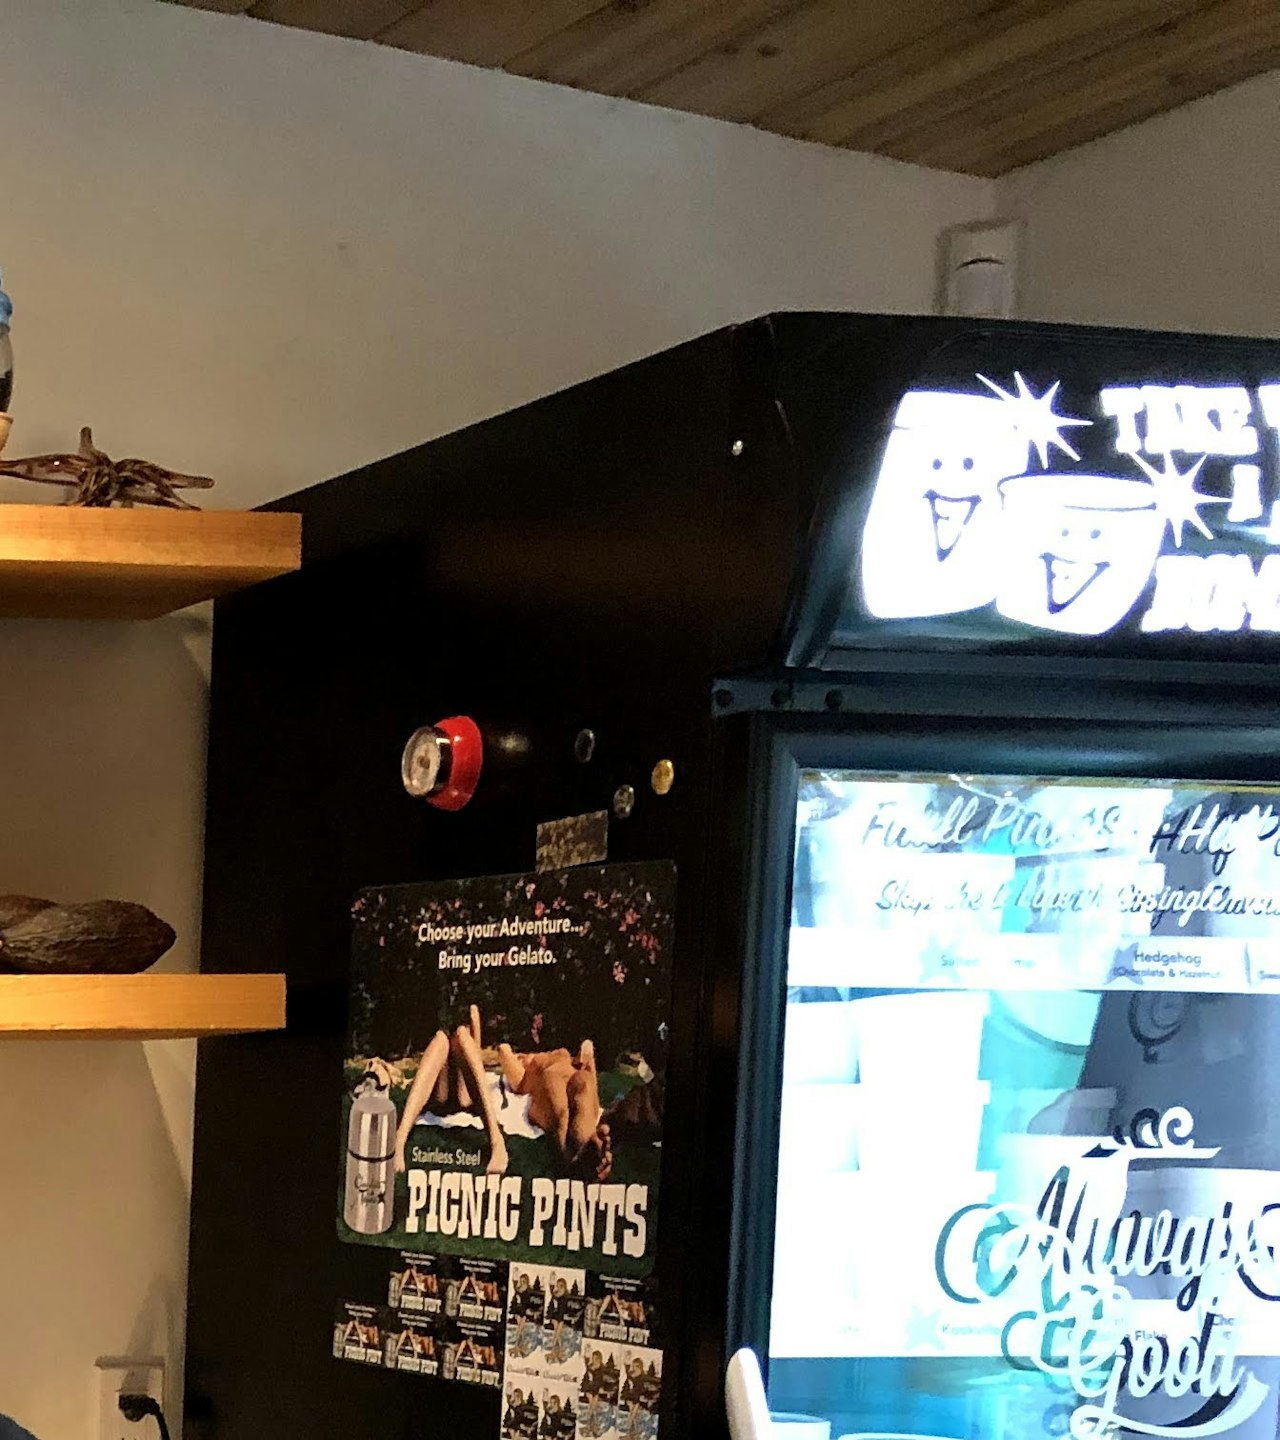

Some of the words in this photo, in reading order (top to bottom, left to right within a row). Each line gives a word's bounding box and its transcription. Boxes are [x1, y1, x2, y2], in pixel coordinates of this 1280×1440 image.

[418, 921, 464, 942] Choose
[467, 923, 497, 944] your
[499, 916, 583, 937] Adventure...
[438, 950, 471, 973] Bring
[474, 952, 505, 973] your
[508, 945, 557, 966] Gelato.
[1134, 951, 1201, 967] Hedgehog
[412, 1146, 453, 1165] Stainless
[455, 1148, 481, 1166] Steel
[405, 1169, 522, 1242] PICNIC
[529, 1178, 648, 1258] PINTS
